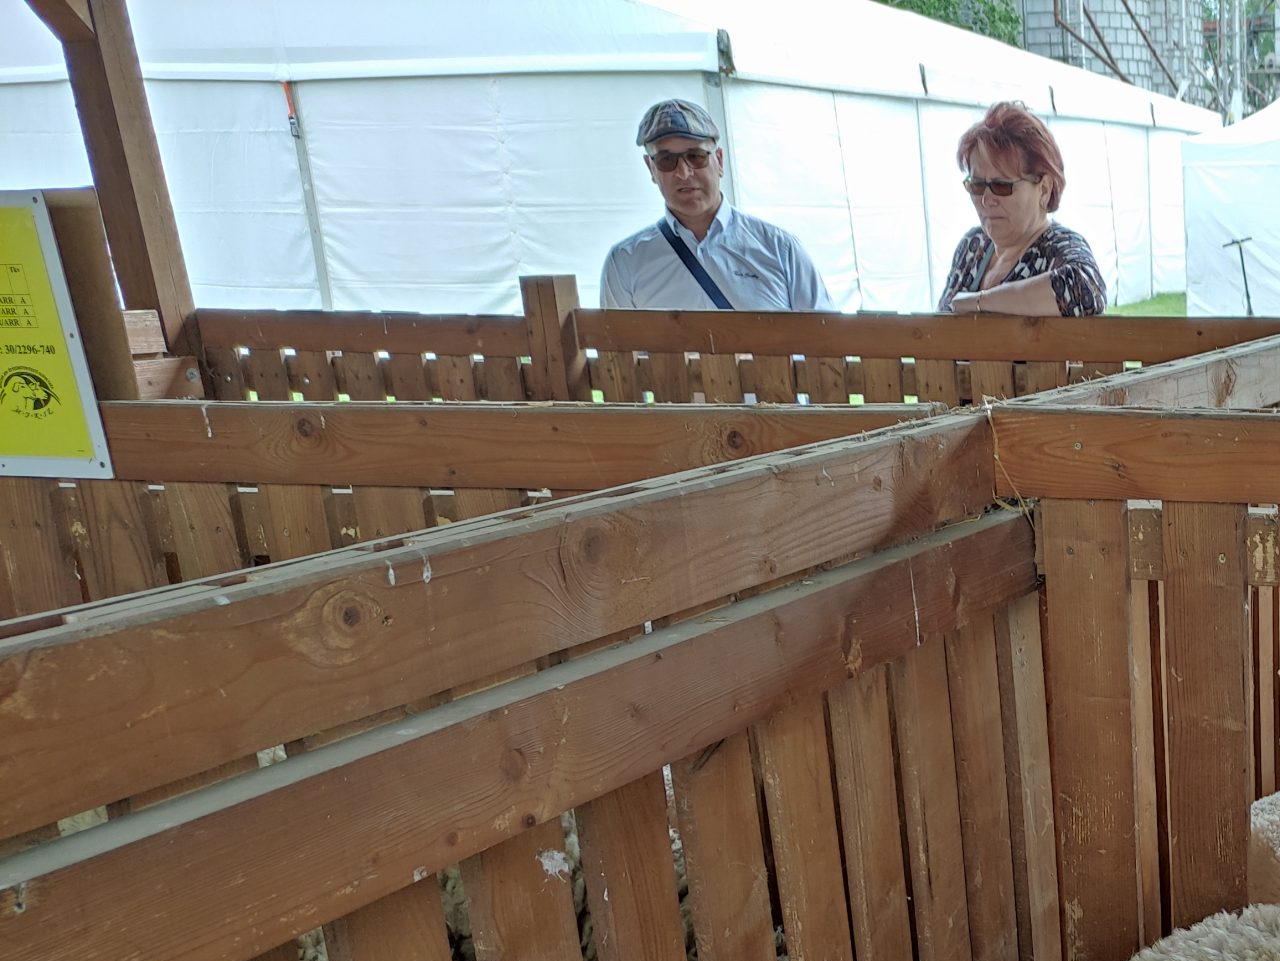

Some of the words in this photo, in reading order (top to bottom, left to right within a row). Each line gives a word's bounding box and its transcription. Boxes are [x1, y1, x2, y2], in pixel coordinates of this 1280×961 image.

[20, 296, 26, 304] A
[23, 308, 30, 316] A
[26, 318, 32, 326] A
